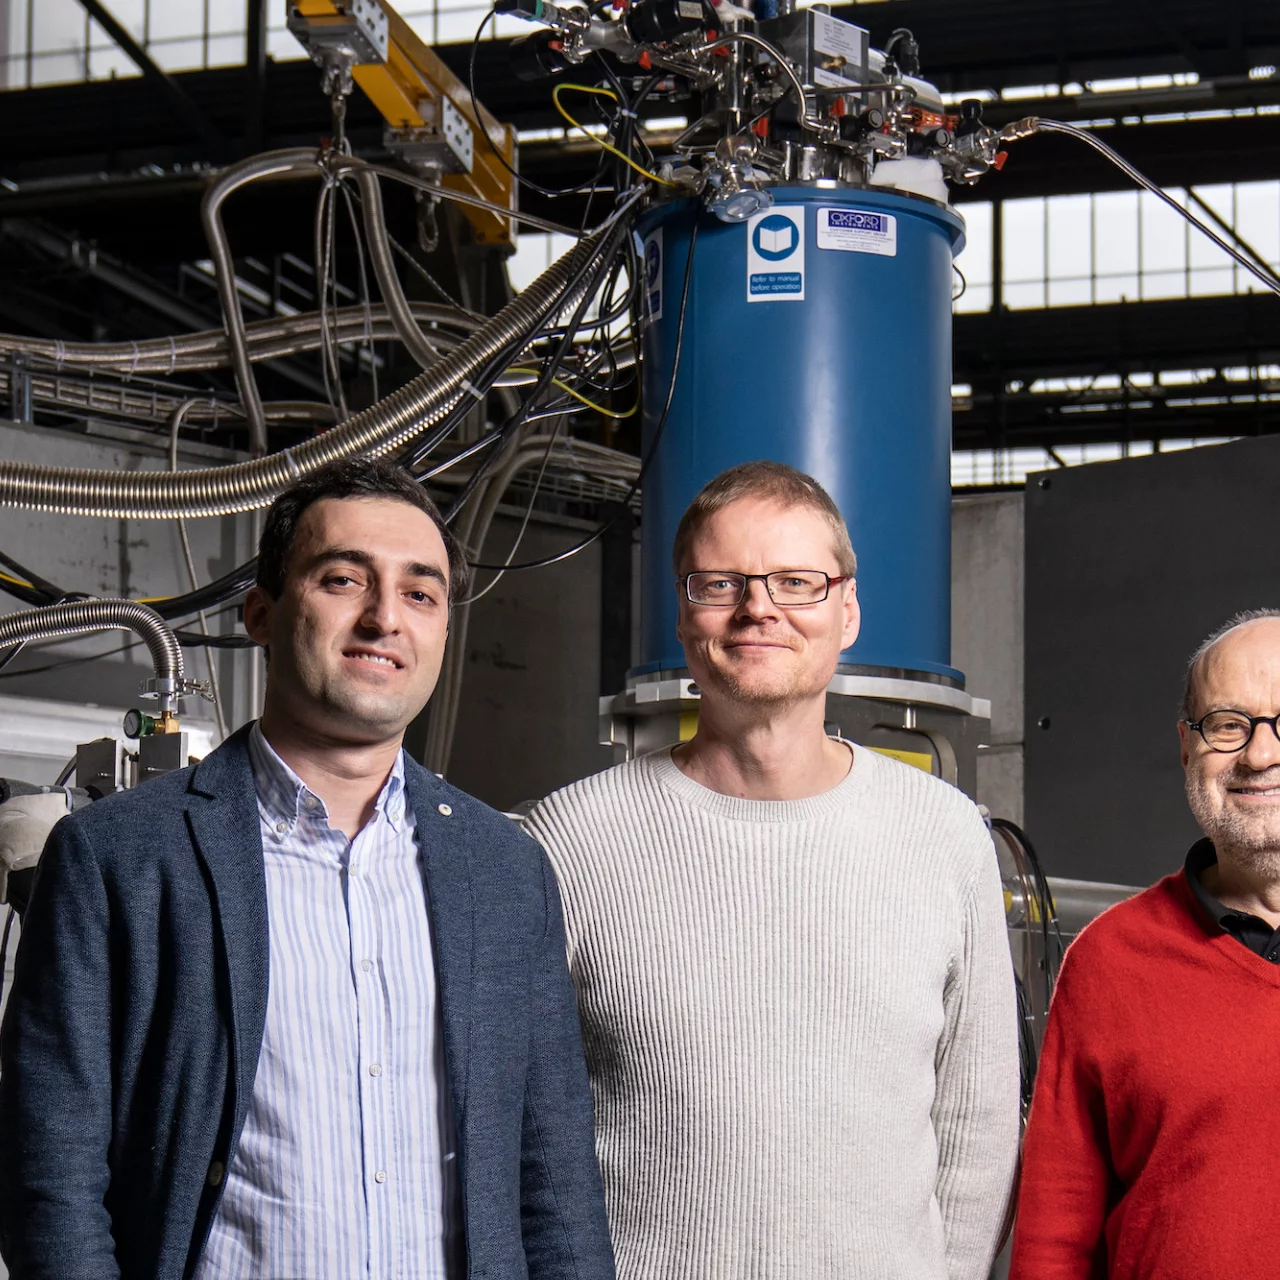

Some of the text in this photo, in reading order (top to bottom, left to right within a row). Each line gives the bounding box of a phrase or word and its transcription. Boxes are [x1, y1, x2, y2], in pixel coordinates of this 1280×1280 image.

[830, 212, 880, 227] OXFORD
[831, 221, 879, 230] INSTRUMENTS
[752, 275, 767, 283] Refer
[771, 283, 801, 291] operation
